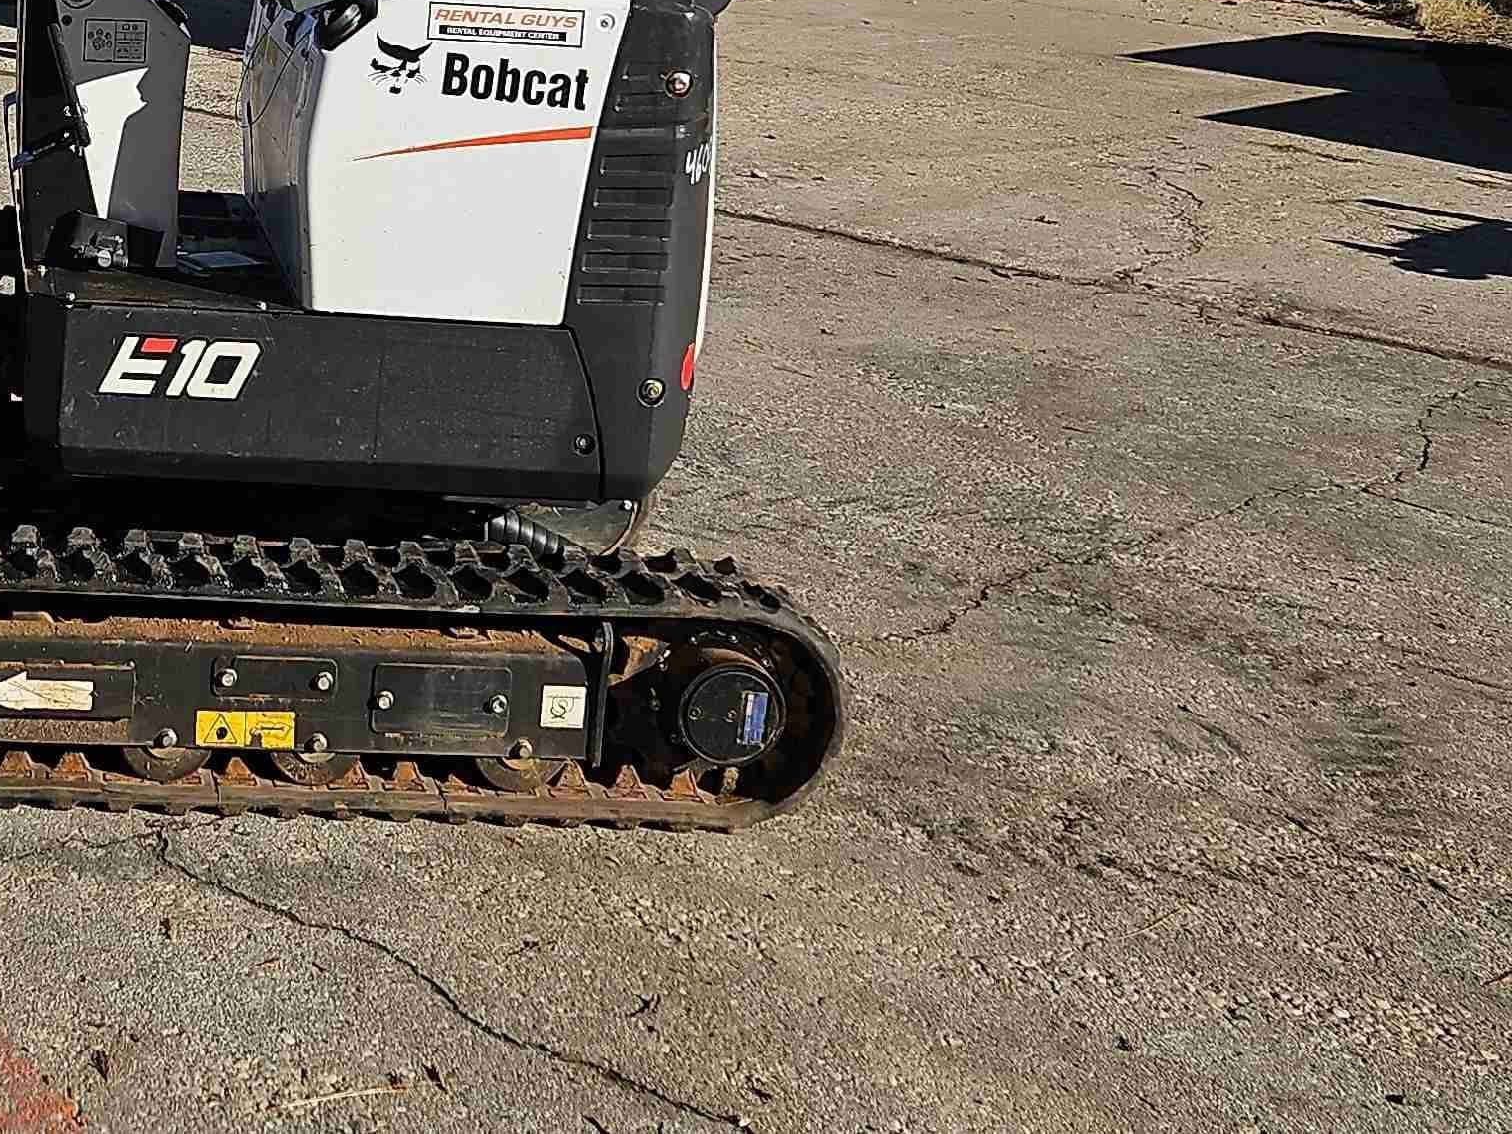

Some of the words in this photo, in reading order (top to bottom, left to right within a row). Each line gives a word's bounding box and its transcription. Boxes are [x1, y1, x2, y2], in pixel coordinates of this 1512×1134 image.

[434, 8, 516, 25] RENTAL
[520, 13, 580, 28] GUYS
[446, 27, 478, 36] RENTAL
[479, 28, 527, 39] EQUIPMENT
[528, 31, 560, 40] CENTER
[441, 51, 590, 112] Bobcat
[98, 336, 262, 400] E10
